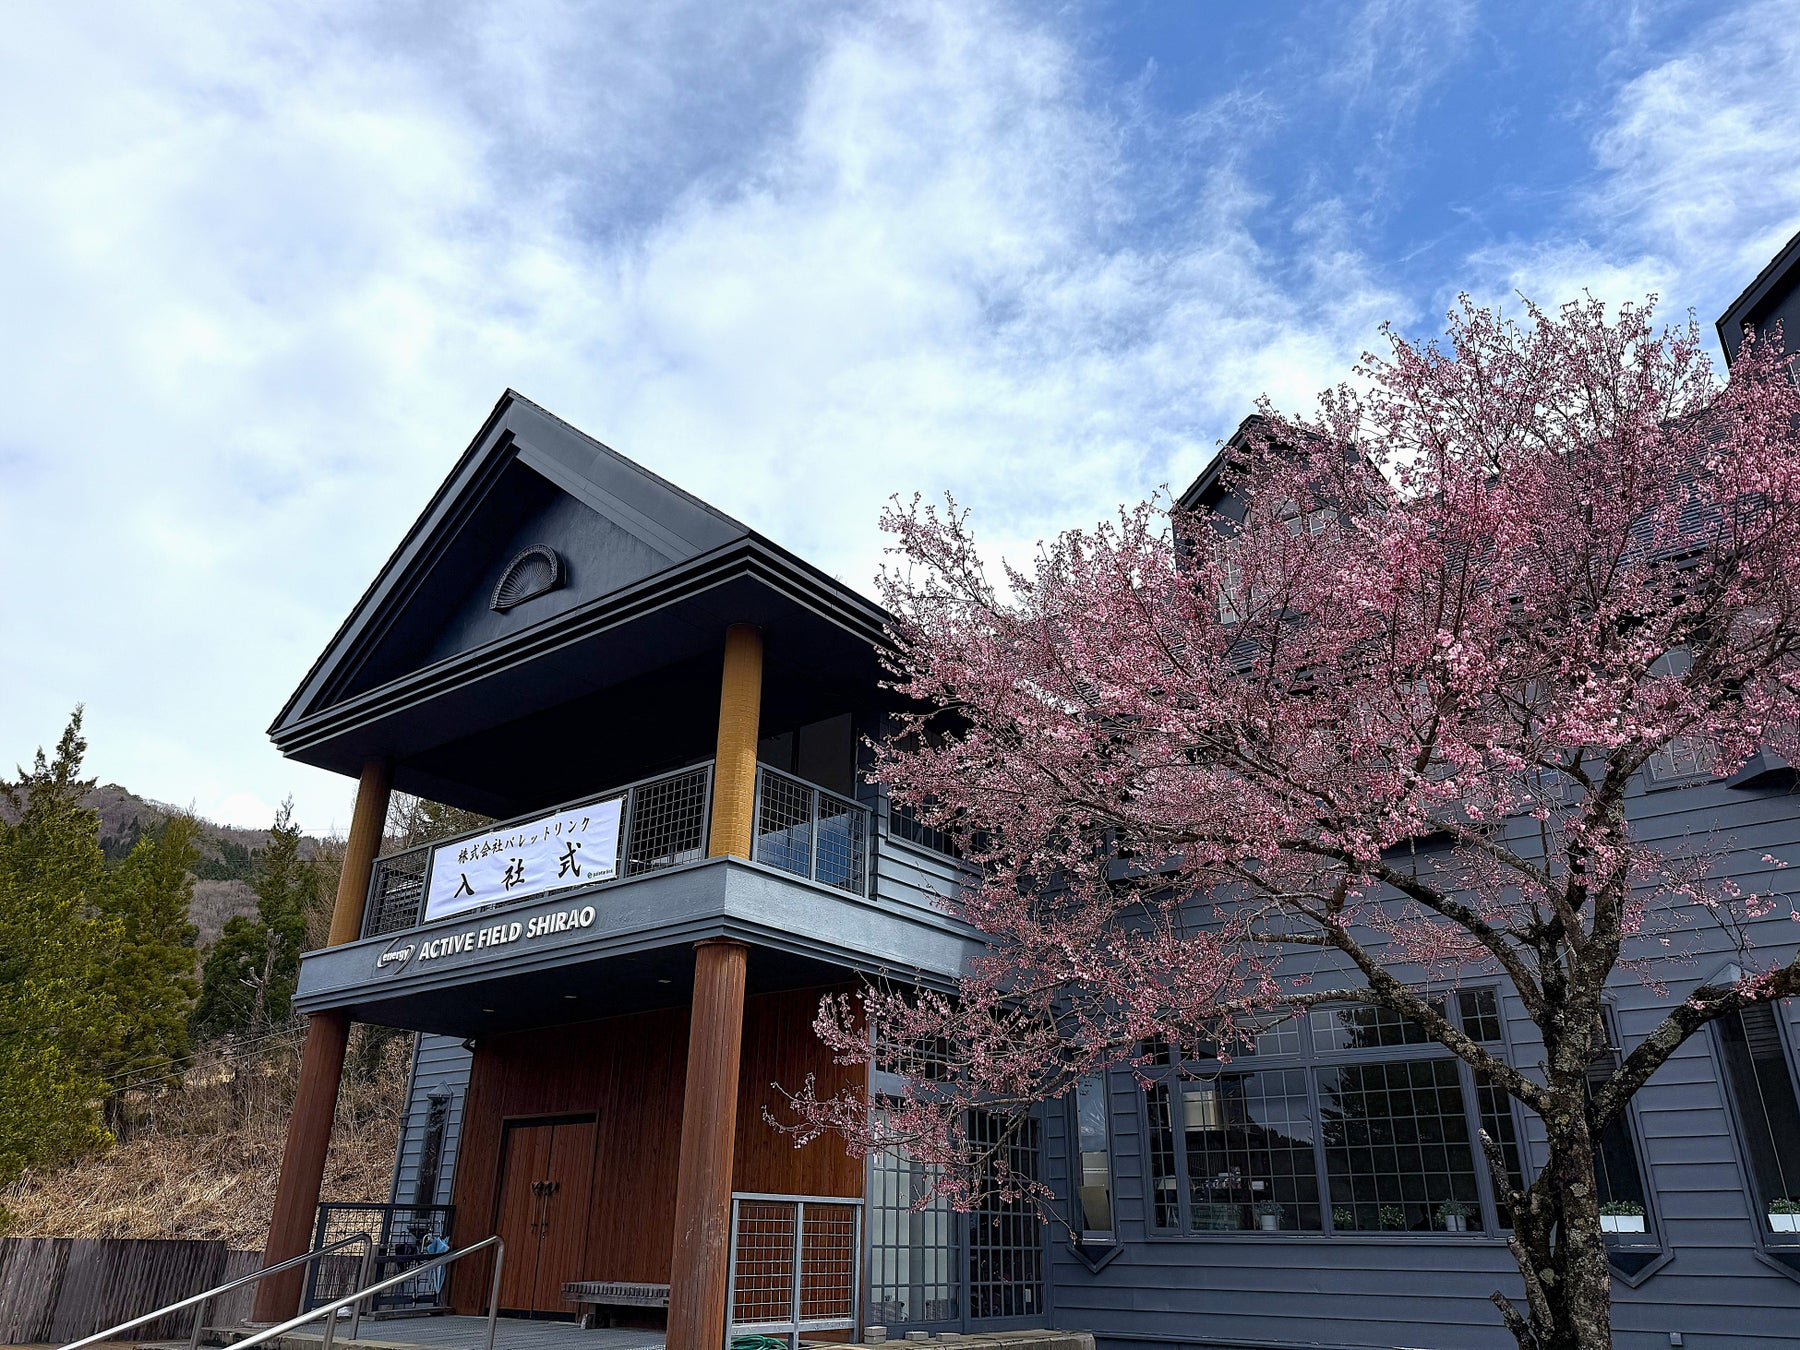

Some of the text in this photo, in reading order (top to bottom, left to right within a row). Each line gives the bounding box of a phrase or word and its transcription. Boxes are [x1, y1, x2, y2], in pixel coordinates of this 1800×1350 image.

[458, 817, 590, 864] 株式会社パレットリンク
[382, 948, 410, 962] energy
[418, 906, 596, 961] ACTIVE FIELD SHIRAO
